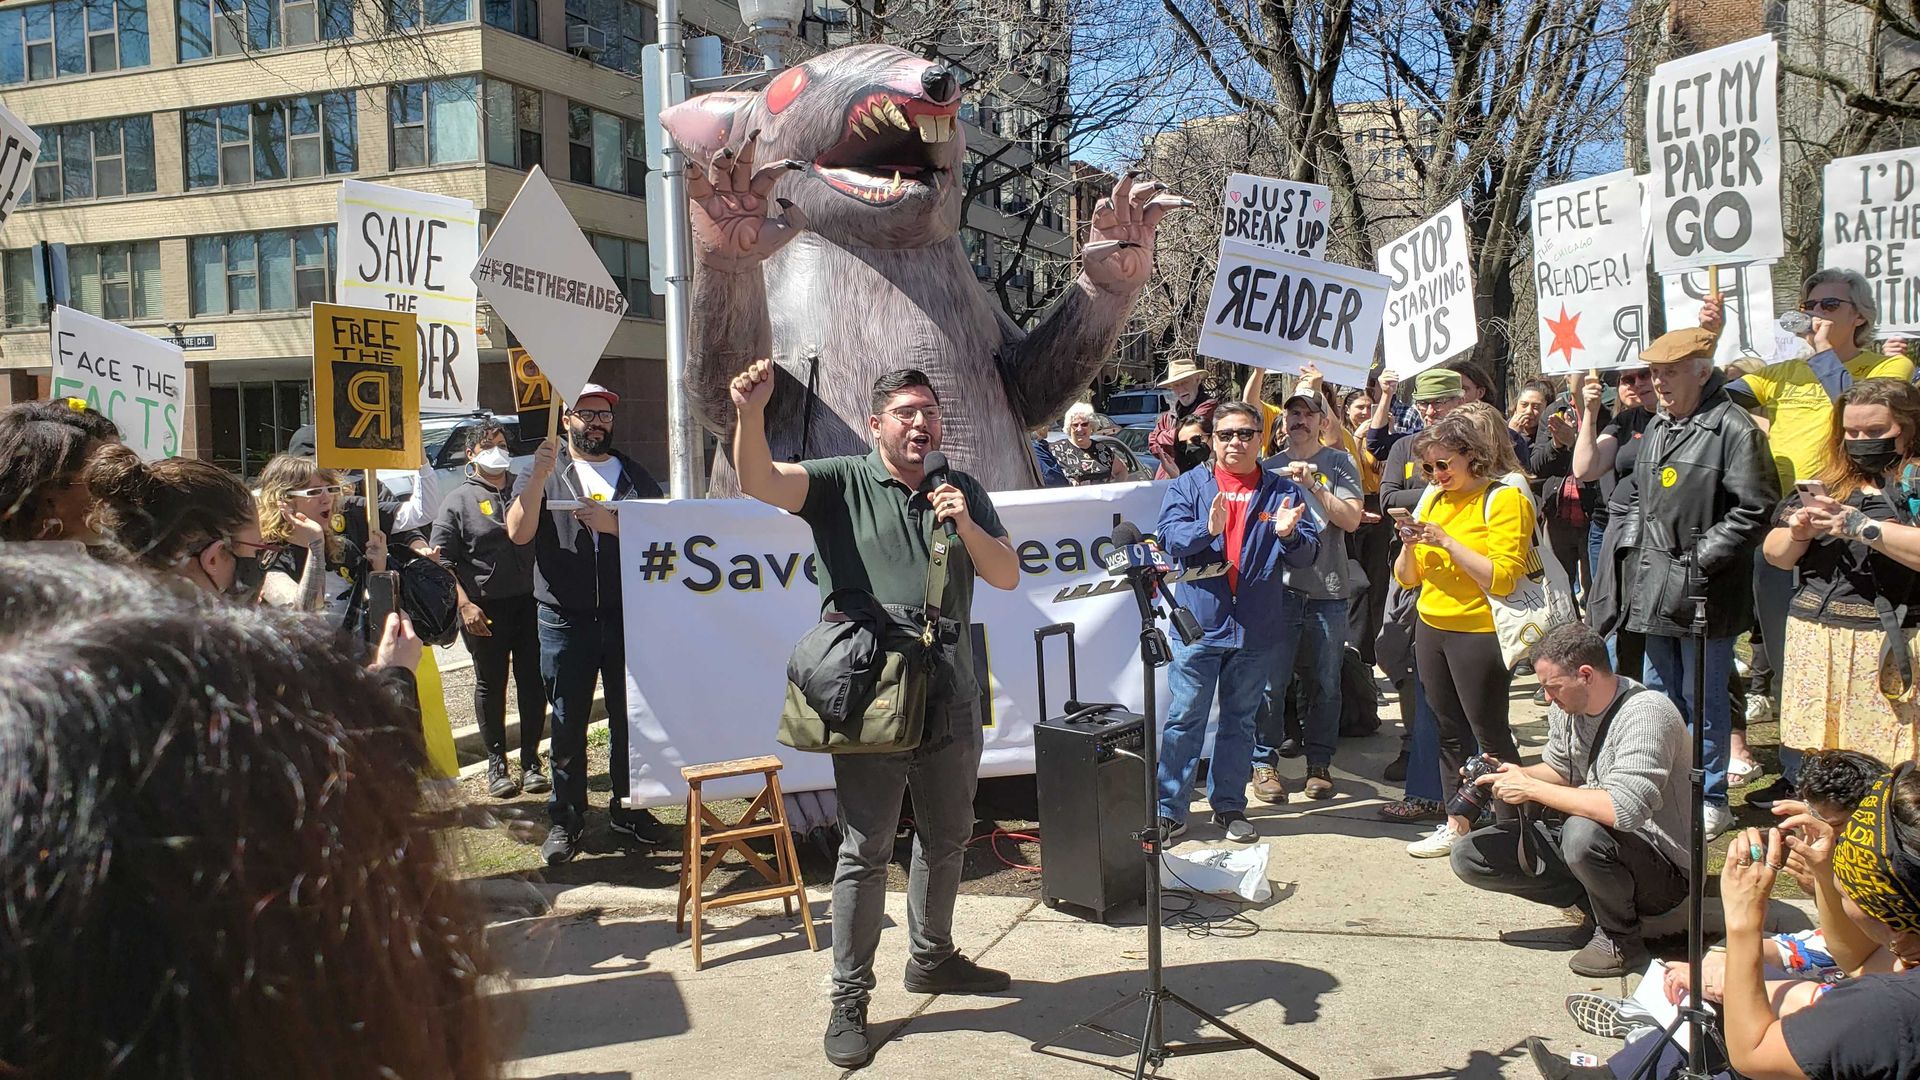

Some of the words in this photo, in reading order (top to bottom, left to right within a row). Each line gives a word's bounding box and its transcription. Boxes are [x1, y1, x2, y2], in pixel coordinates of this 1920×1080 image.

[1656, 71, 1712, 143] LET
[1718, 55, 1765, 128] MY
[1664, 127, 1763, 198] PAPER
[1859, 159, 1914, 205] I'D
[1243, 184, 1311, 217] JUST
[1537, 186, 1612, 236] FREE
[1666, 190, 1752, 257] GO
[1224, 207, 1288, 245] BREAK
[1296, 218, 1325, 250] UP
[1834, 204, 1920, 244] RATHE
[359, 212, 447, 291] SAVE
[1390, 215, 1452, 291] STOP
[1536, 238, 1554, 261] THE
[1554, 236, 1593, 263] CHICAGO
[1864, 242, 1906, 278] BE
[1389, 261, 1467, 327] STARVING
[1537, 253, 1631, 299] READER!
[385, 293, 418, 312] THE
[1215, 265, 1363, 354] READER
[196, 337, 209, 346] DR.
[332, 316, 401, 351] FREE
[334, 347, 395, 364] THE
[1409, 306, 1451, 363] US
[58, 331, 122, 382] FACE
[132, 364, 177, 397] THE
[417, 323, 463, 402] DER
[1017, 512, 1160, 574] ead
[1105, 549, 1128, 567] WGN
[1133, 543, 1146, 565] 9
[1545, 610, 1563, 627] the
